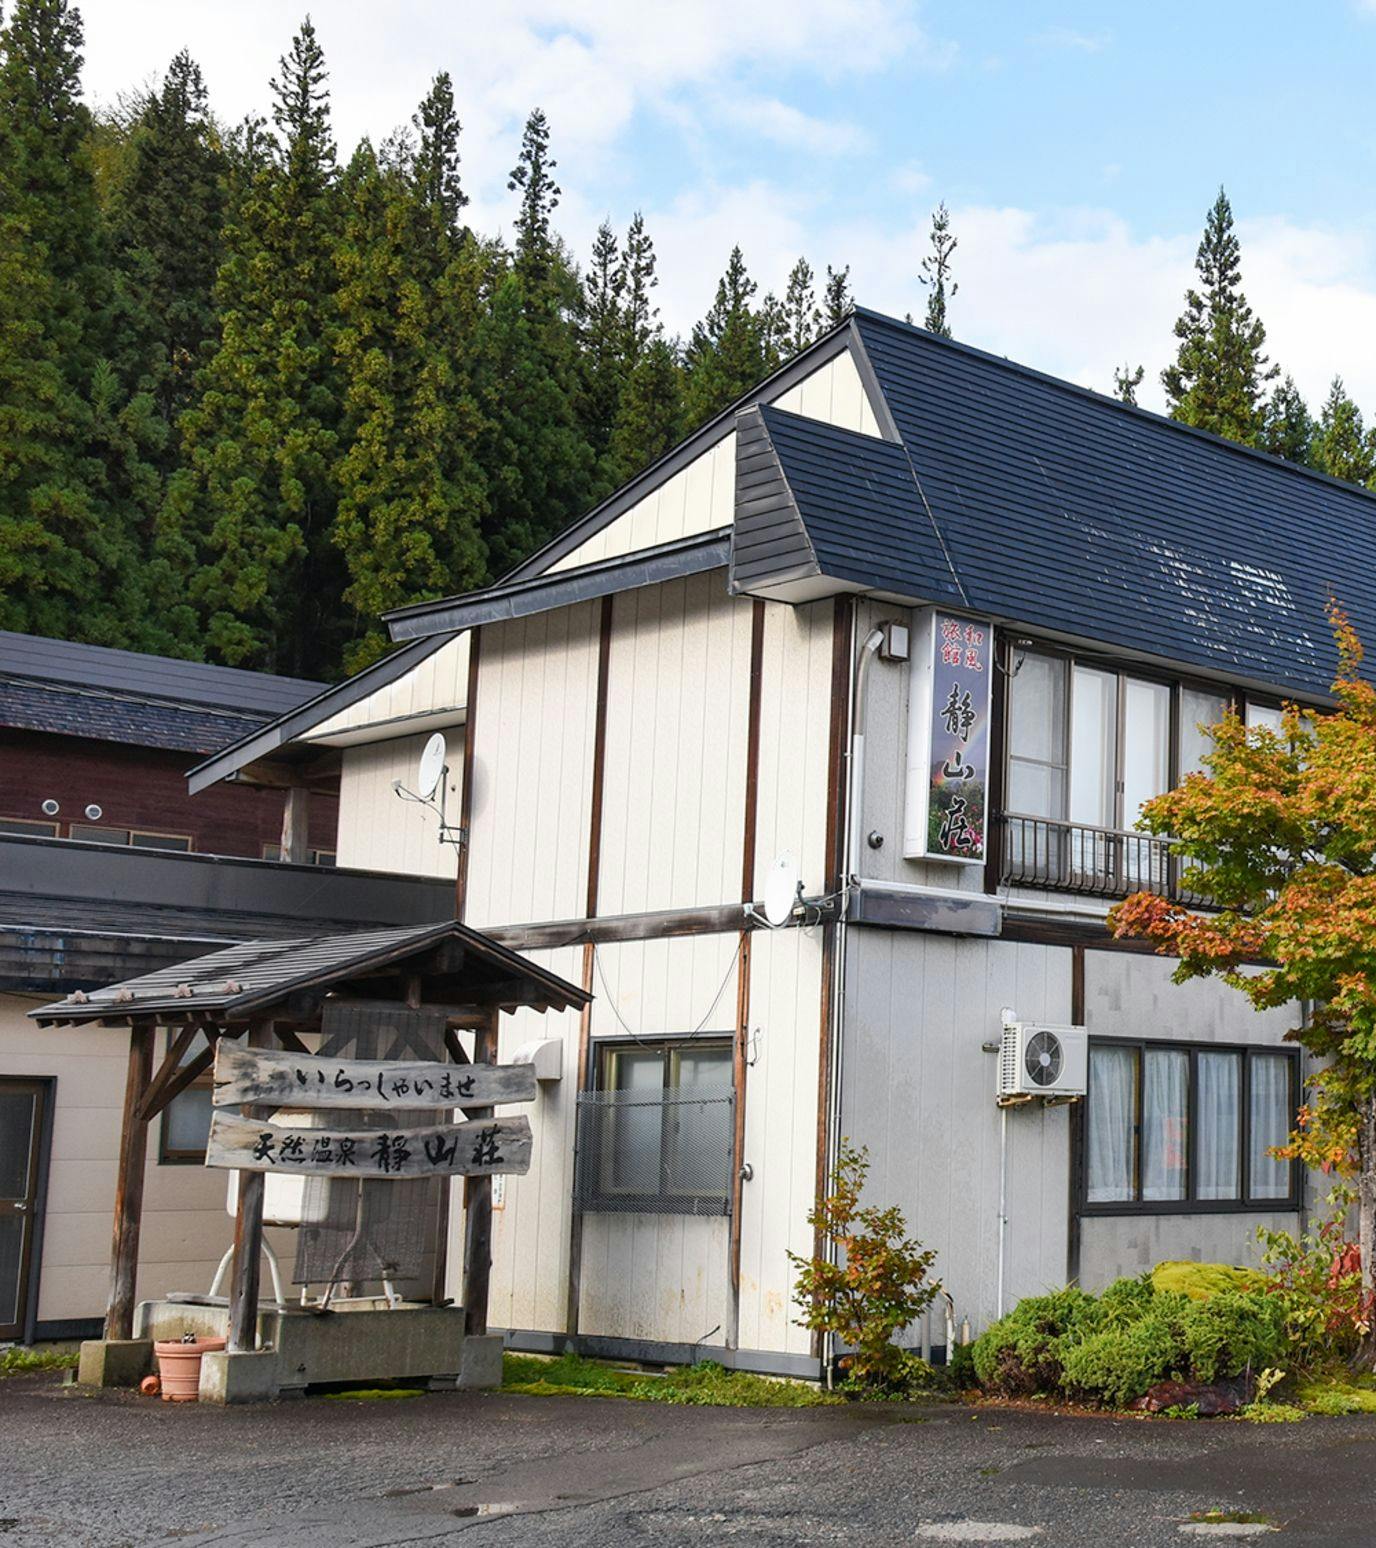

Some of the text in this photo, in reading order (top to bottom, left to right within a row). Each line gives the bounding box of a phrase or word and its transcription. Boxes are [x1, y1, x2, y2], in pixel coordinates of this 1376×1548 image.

[941, 618, 963, 666] 旅館
[296, 1068, 476, 1101] いらっしゃいませ
[253, 1133, 357, 1165] 天然温泉
